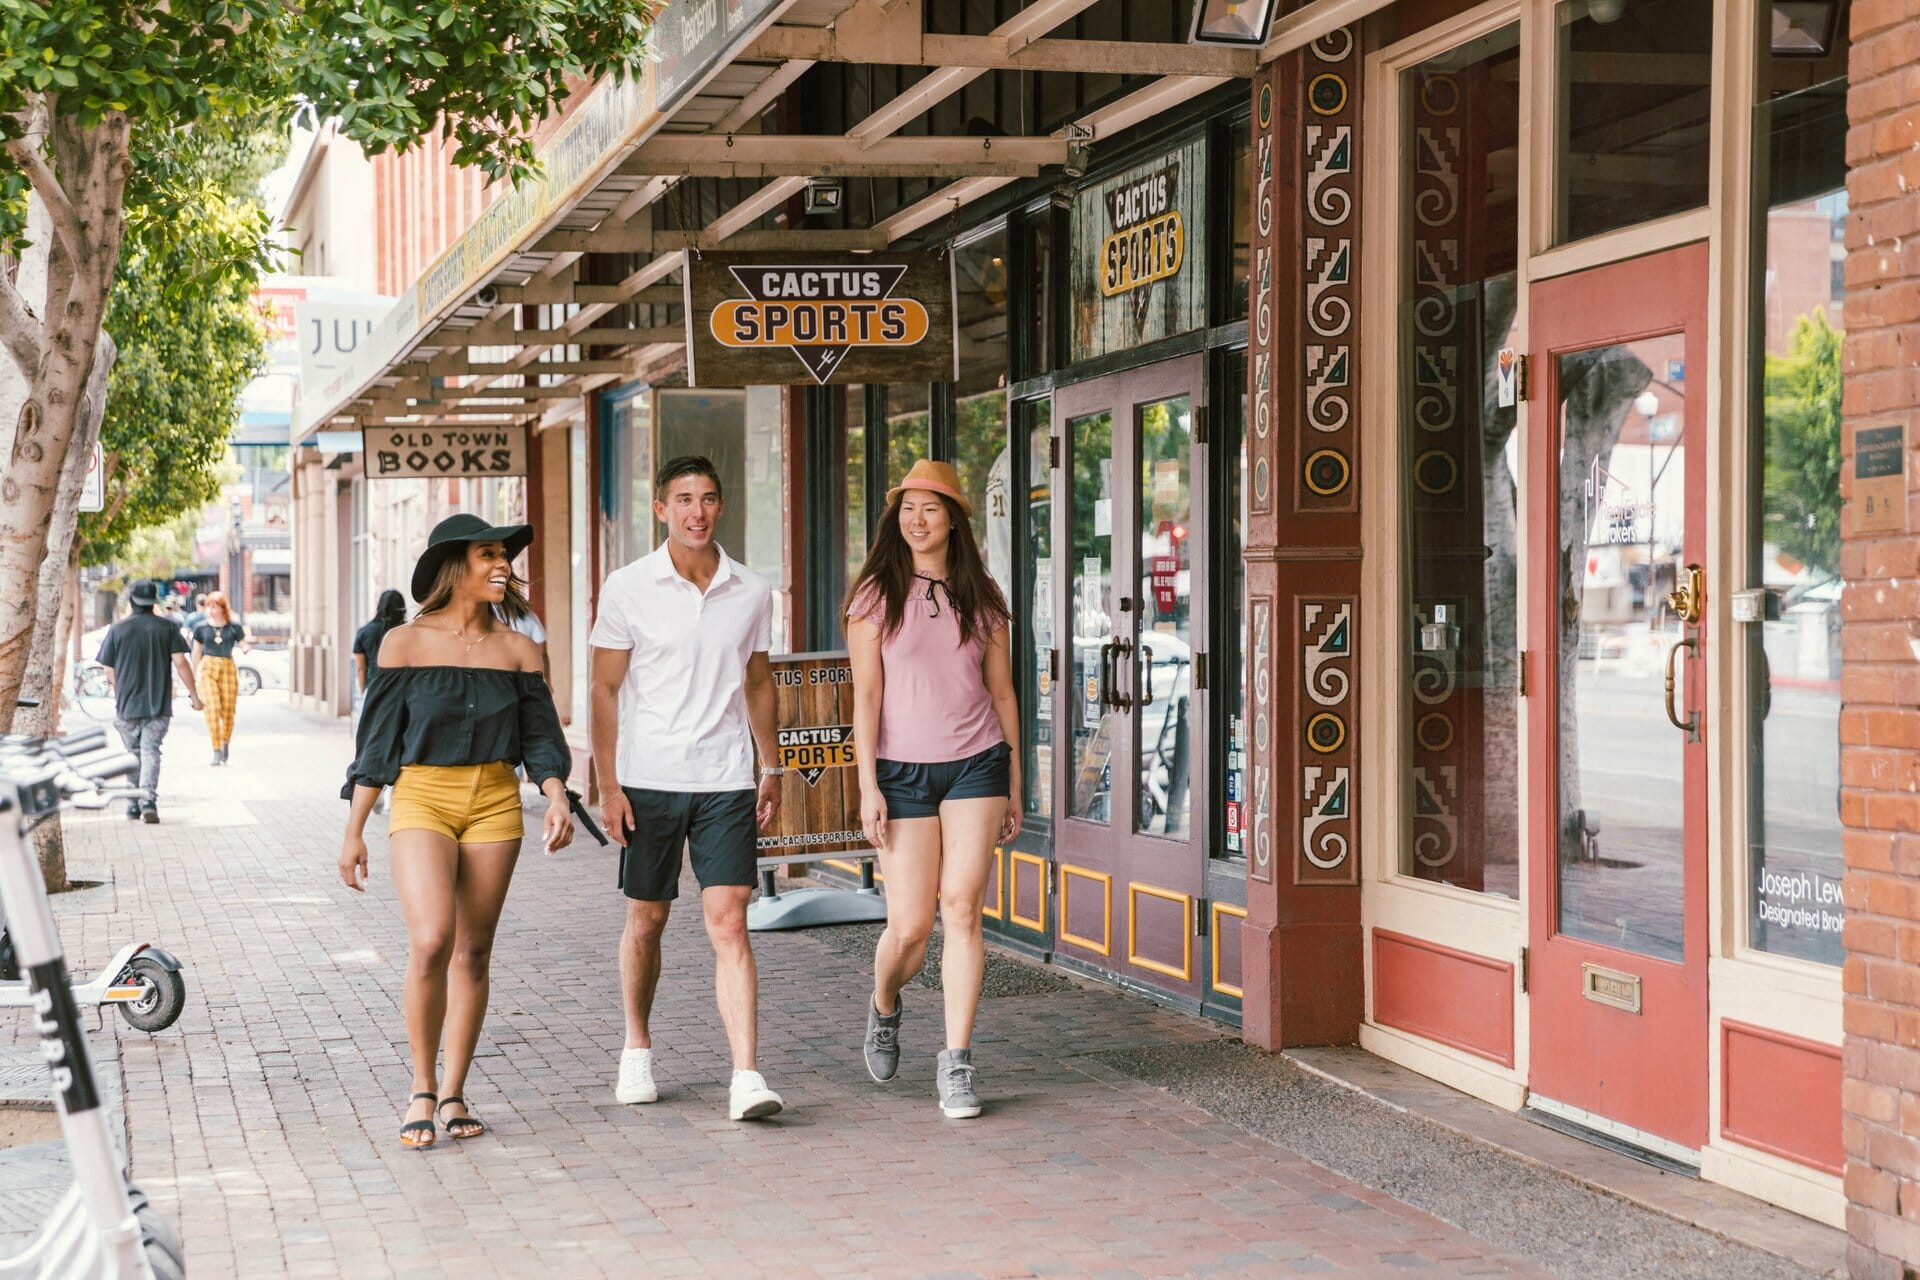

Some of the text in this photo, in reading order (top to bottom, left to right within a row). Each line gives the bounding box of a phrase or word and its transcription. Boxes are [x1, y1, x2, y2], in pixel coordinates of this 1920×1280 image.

[1116, 175, 1167, 229] CACTUS
[1107, 215, 1177, 290] SPORTS
[762, 272, 880, 297] CACTUS
[733, 303, 906, 343] SPORTS
[390, 432, 508, 447] OLD TOWN
[378, 450, 511, 474] BOOKS
[778, 728, 841, 746] CACTUS
[1758, 867, 1811, 904] Joseph
[1759, 900, 1820, 928] Designated
